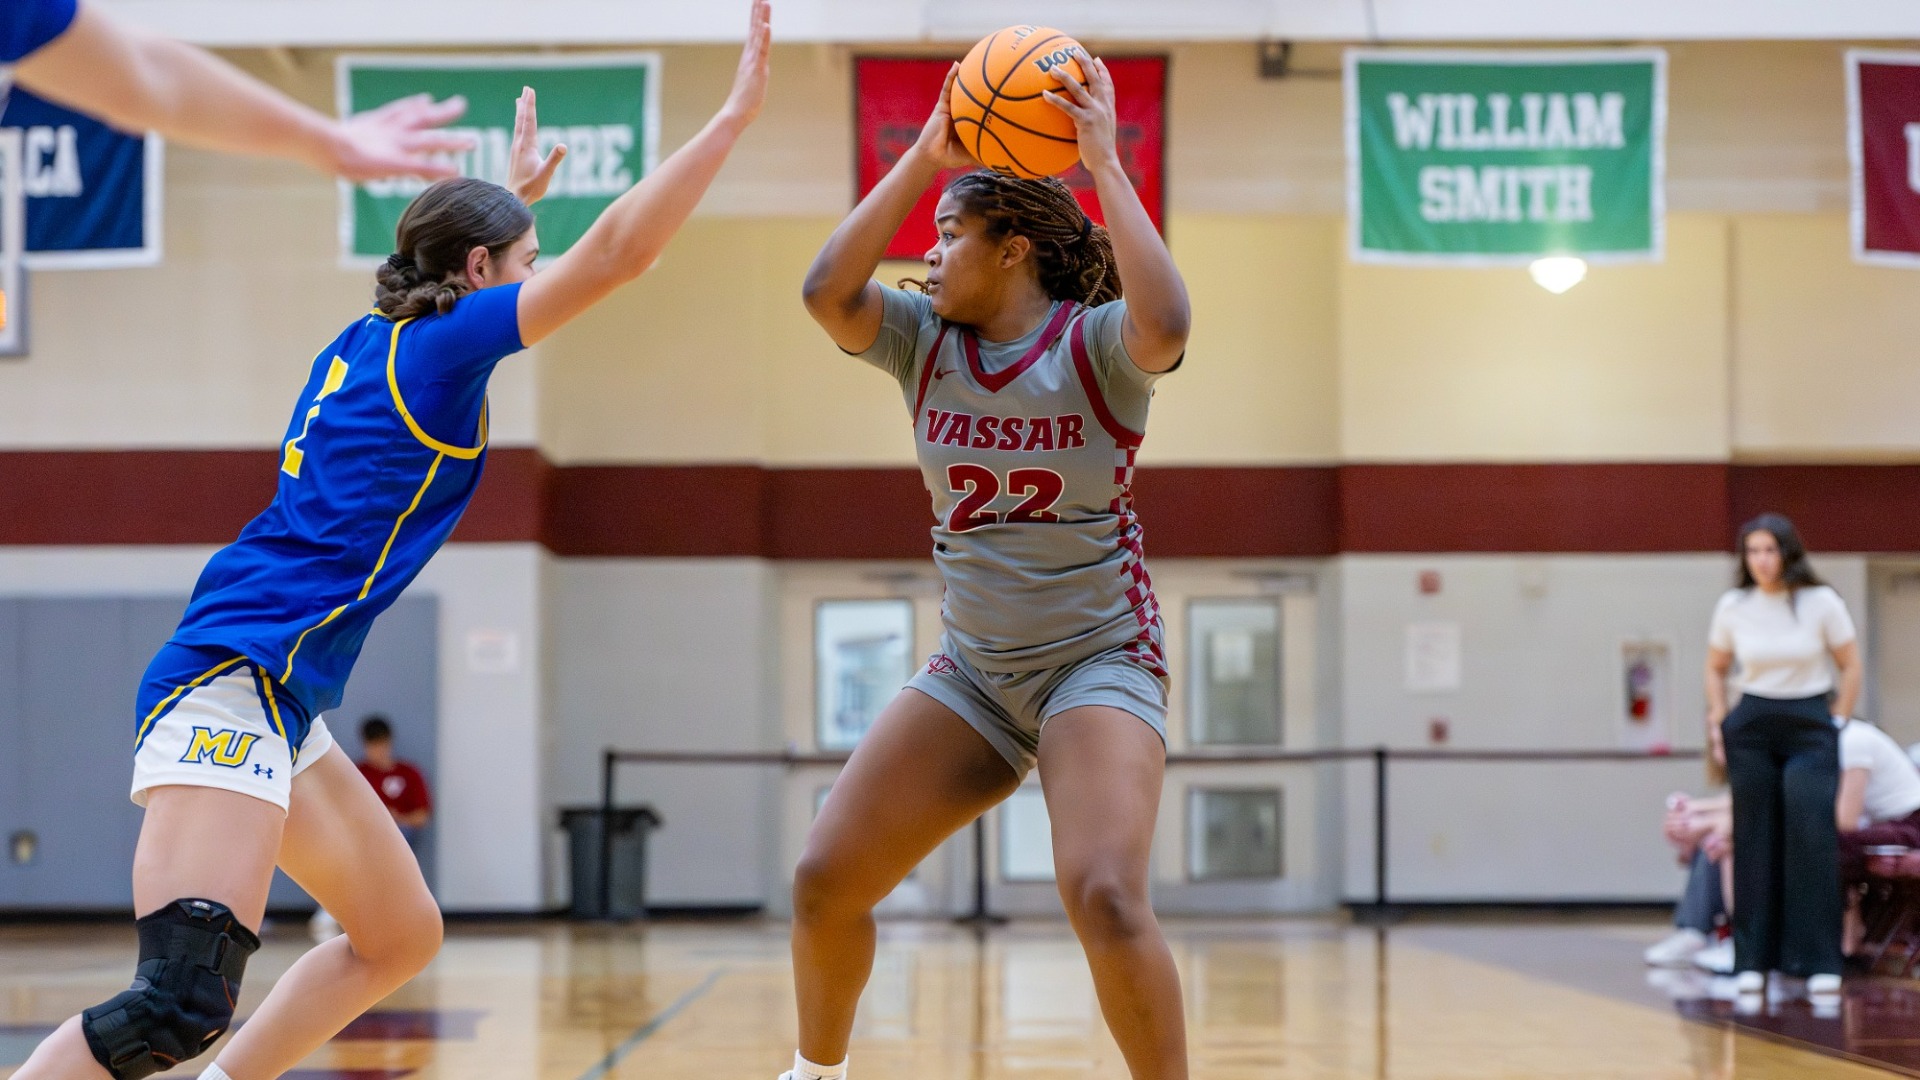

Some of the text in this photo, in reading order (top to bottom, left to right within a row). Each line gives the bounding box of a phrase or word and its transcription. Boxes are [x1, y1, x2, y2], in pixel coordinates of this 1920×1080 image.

[1387, 92, 1625, 149] WILLIAM
[26, 124, 83, 198] CA
[1419, 165, 1594, 222] SMITH
[926, 408, 1086, 452] VASSAR
[947, 463, 1065, 533] 22
[178, 726, 263, 768] MU
